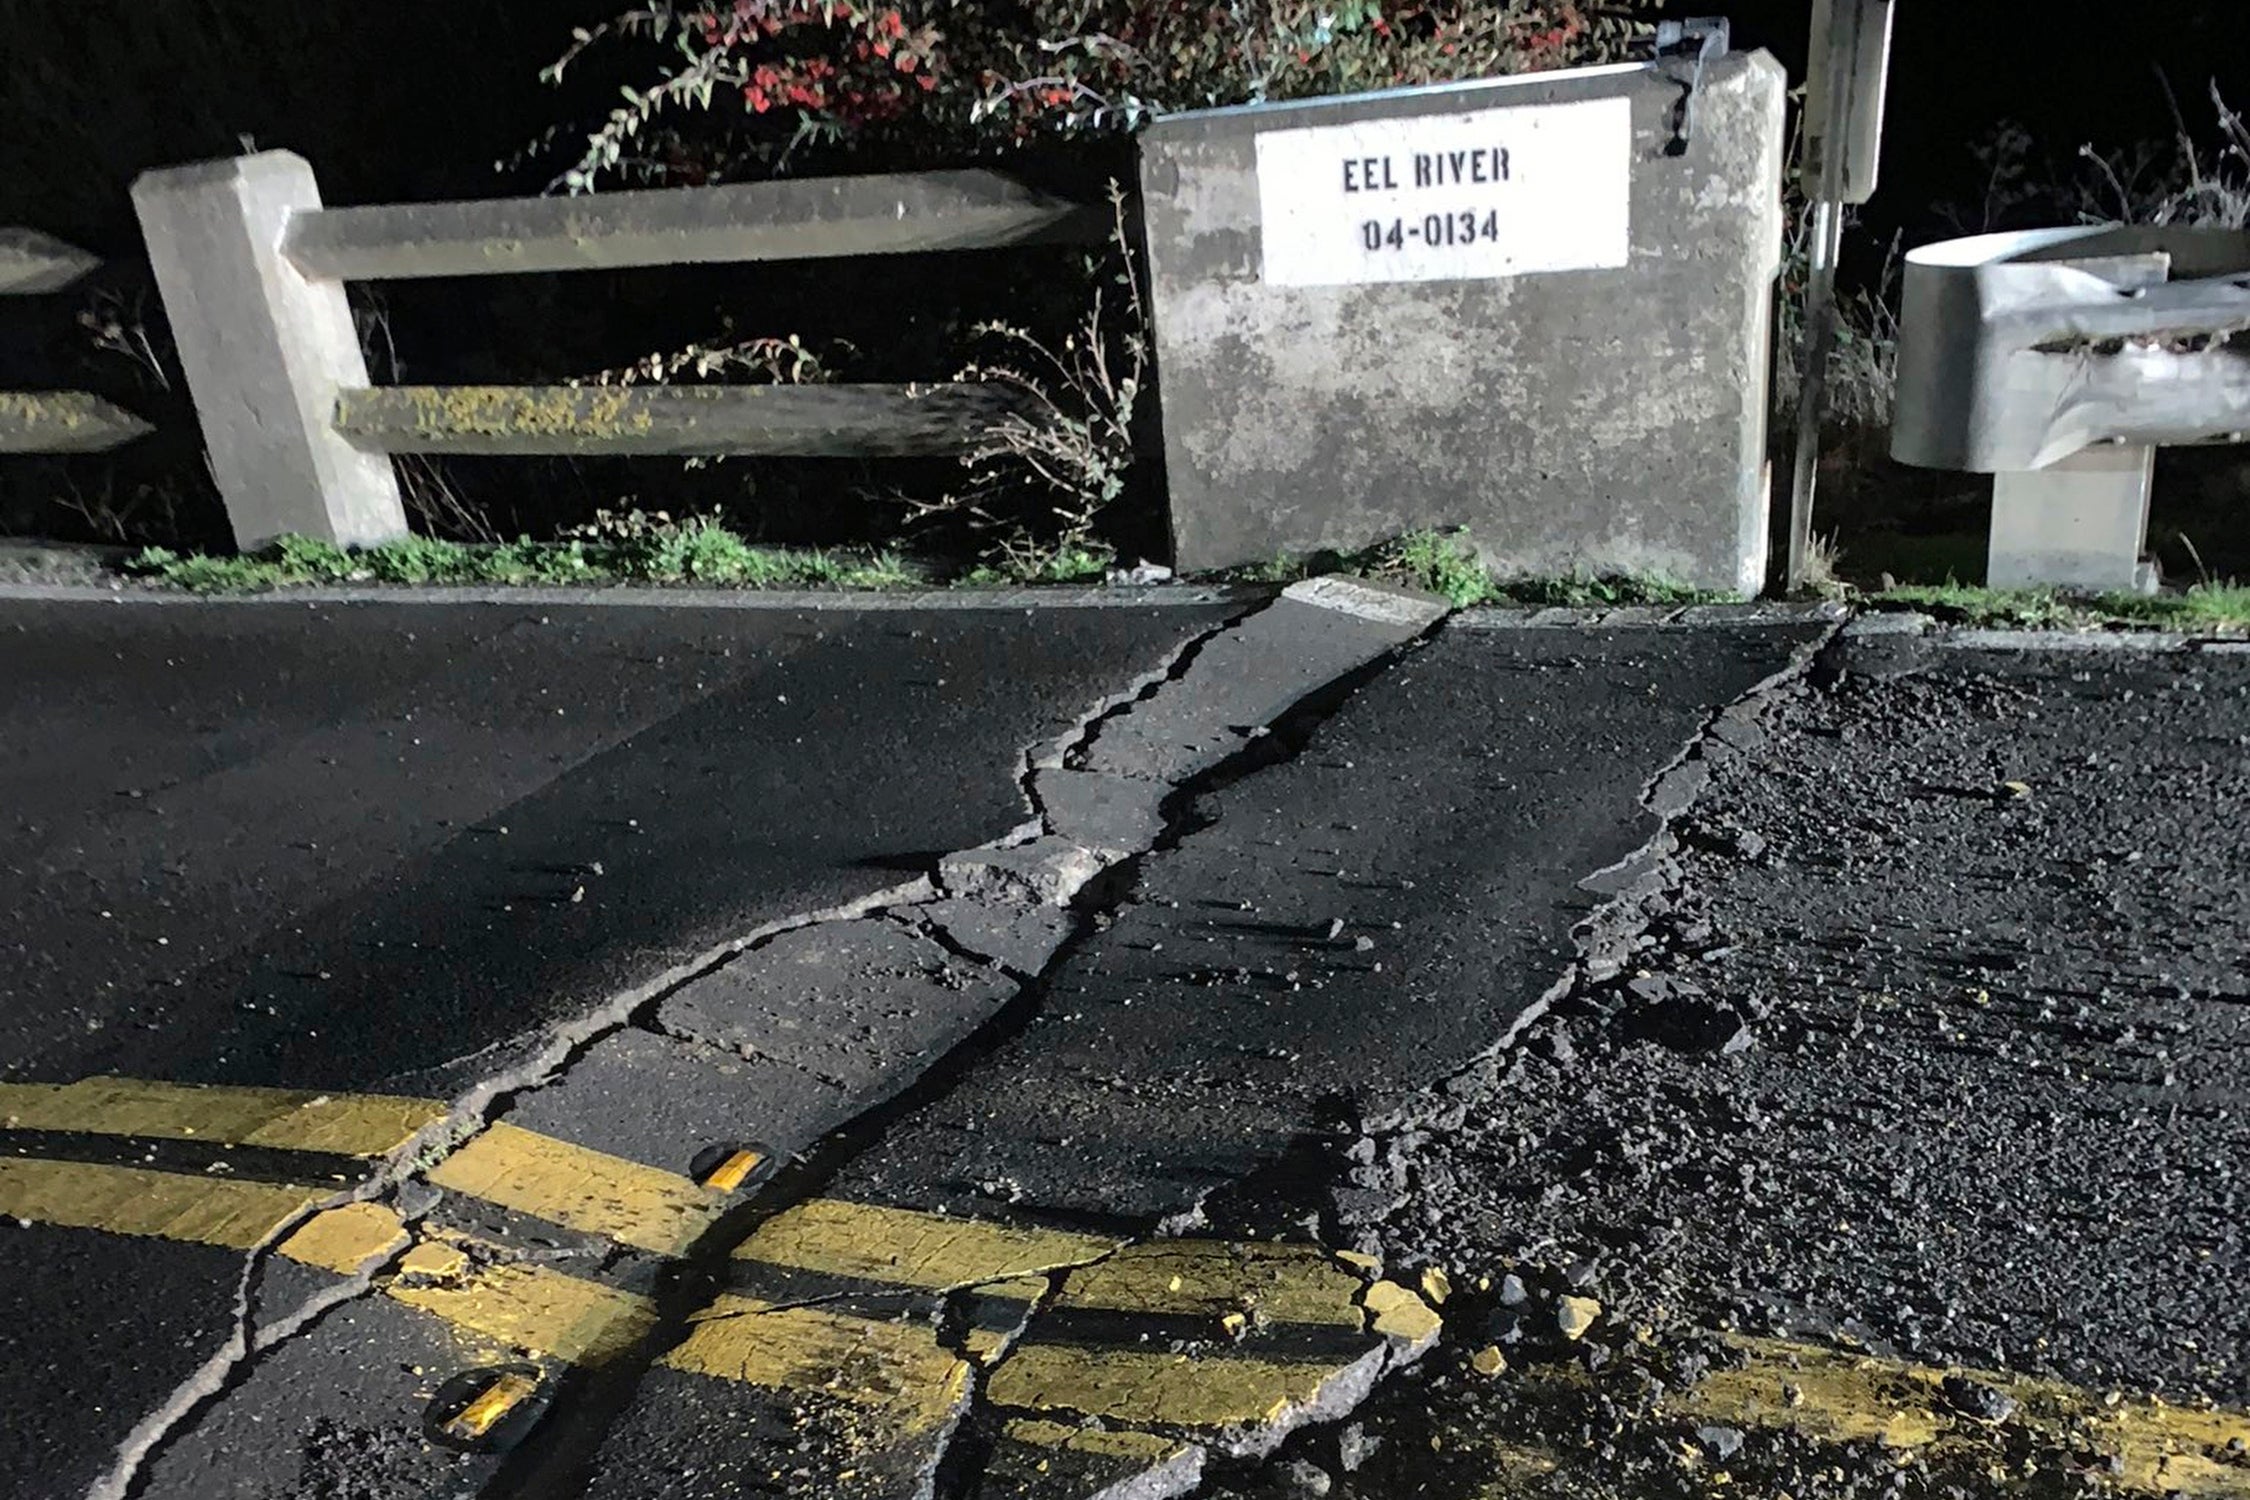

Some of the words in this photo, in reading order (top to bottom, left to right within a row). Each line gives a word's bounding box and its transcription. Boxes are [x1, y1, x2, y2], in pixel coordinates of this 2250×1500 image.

[1343, 156, 1397, 192] EEL
[1415, 148, 1510, 188] RIVER
[1362, 210, 1498, 251] 04-0134
